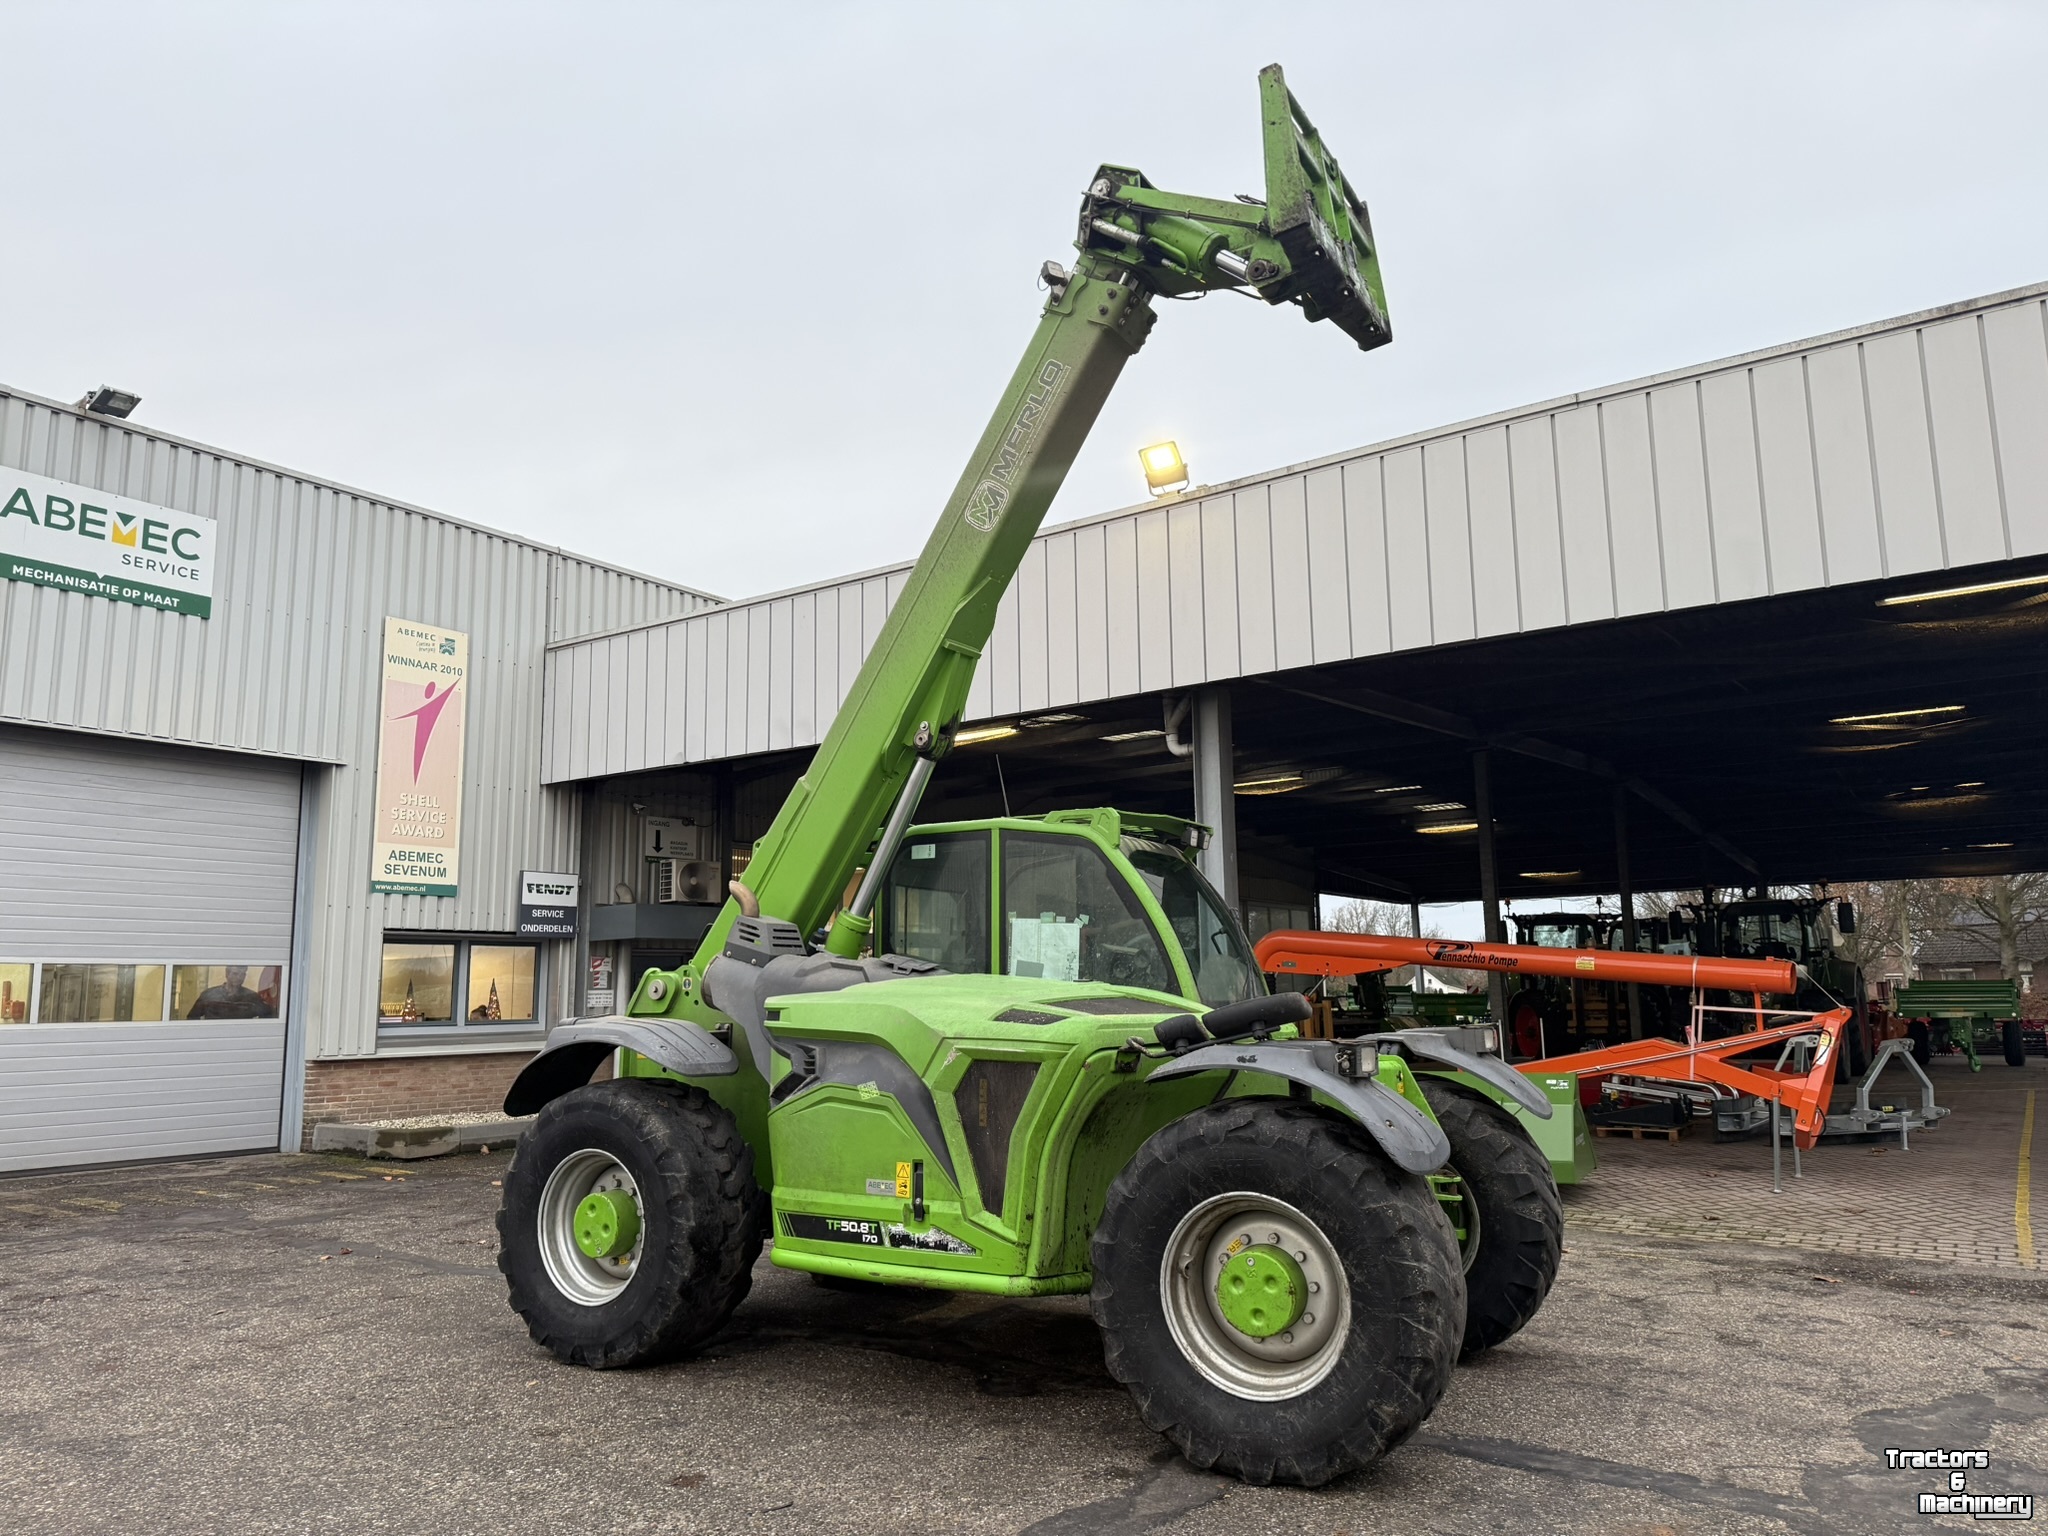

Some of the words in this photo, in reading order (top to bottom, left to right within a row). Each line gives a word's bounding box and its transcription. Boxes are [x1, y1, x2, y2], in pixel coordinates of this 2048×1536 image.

[989, 358, 1064, 483] MERLO
[0, 487, 201, 561] ABEMEC
[121, 553, 200, 581] SERVICE
[12, 564, 119, 596] MECHANISATIE
[122, 587, 141, 599] OP
[144, 591, 180, 608] MAAT
[397, 627, 437, 641] ABEMEC
[387, 653, 438, 672] WINNAAR
[440, 664, 463, 677] 2010
[399, 792, 440, 809] SHELL
[390, 807, 447, 825] SERVICE
[390, 822, 445, 840] AWARD
[388, 850, 444, 864] ABEMEC
[384, 863, 447, 878] SEVENUM
[375, 883, 426, 892] www.abemec.nl
[526, 883, 575, 896] FENDT
[531, 909, 565, 919] SERVICE
[521, 923, 573, 934] ONDERDELEN
[1431, 940, 1486, 965] Pennacchio
[1488, 953, 1519, 968] Pompe
[825, 1219, 878, 1234] TF50.8T
[862, 1234, 878, 1243] 170
